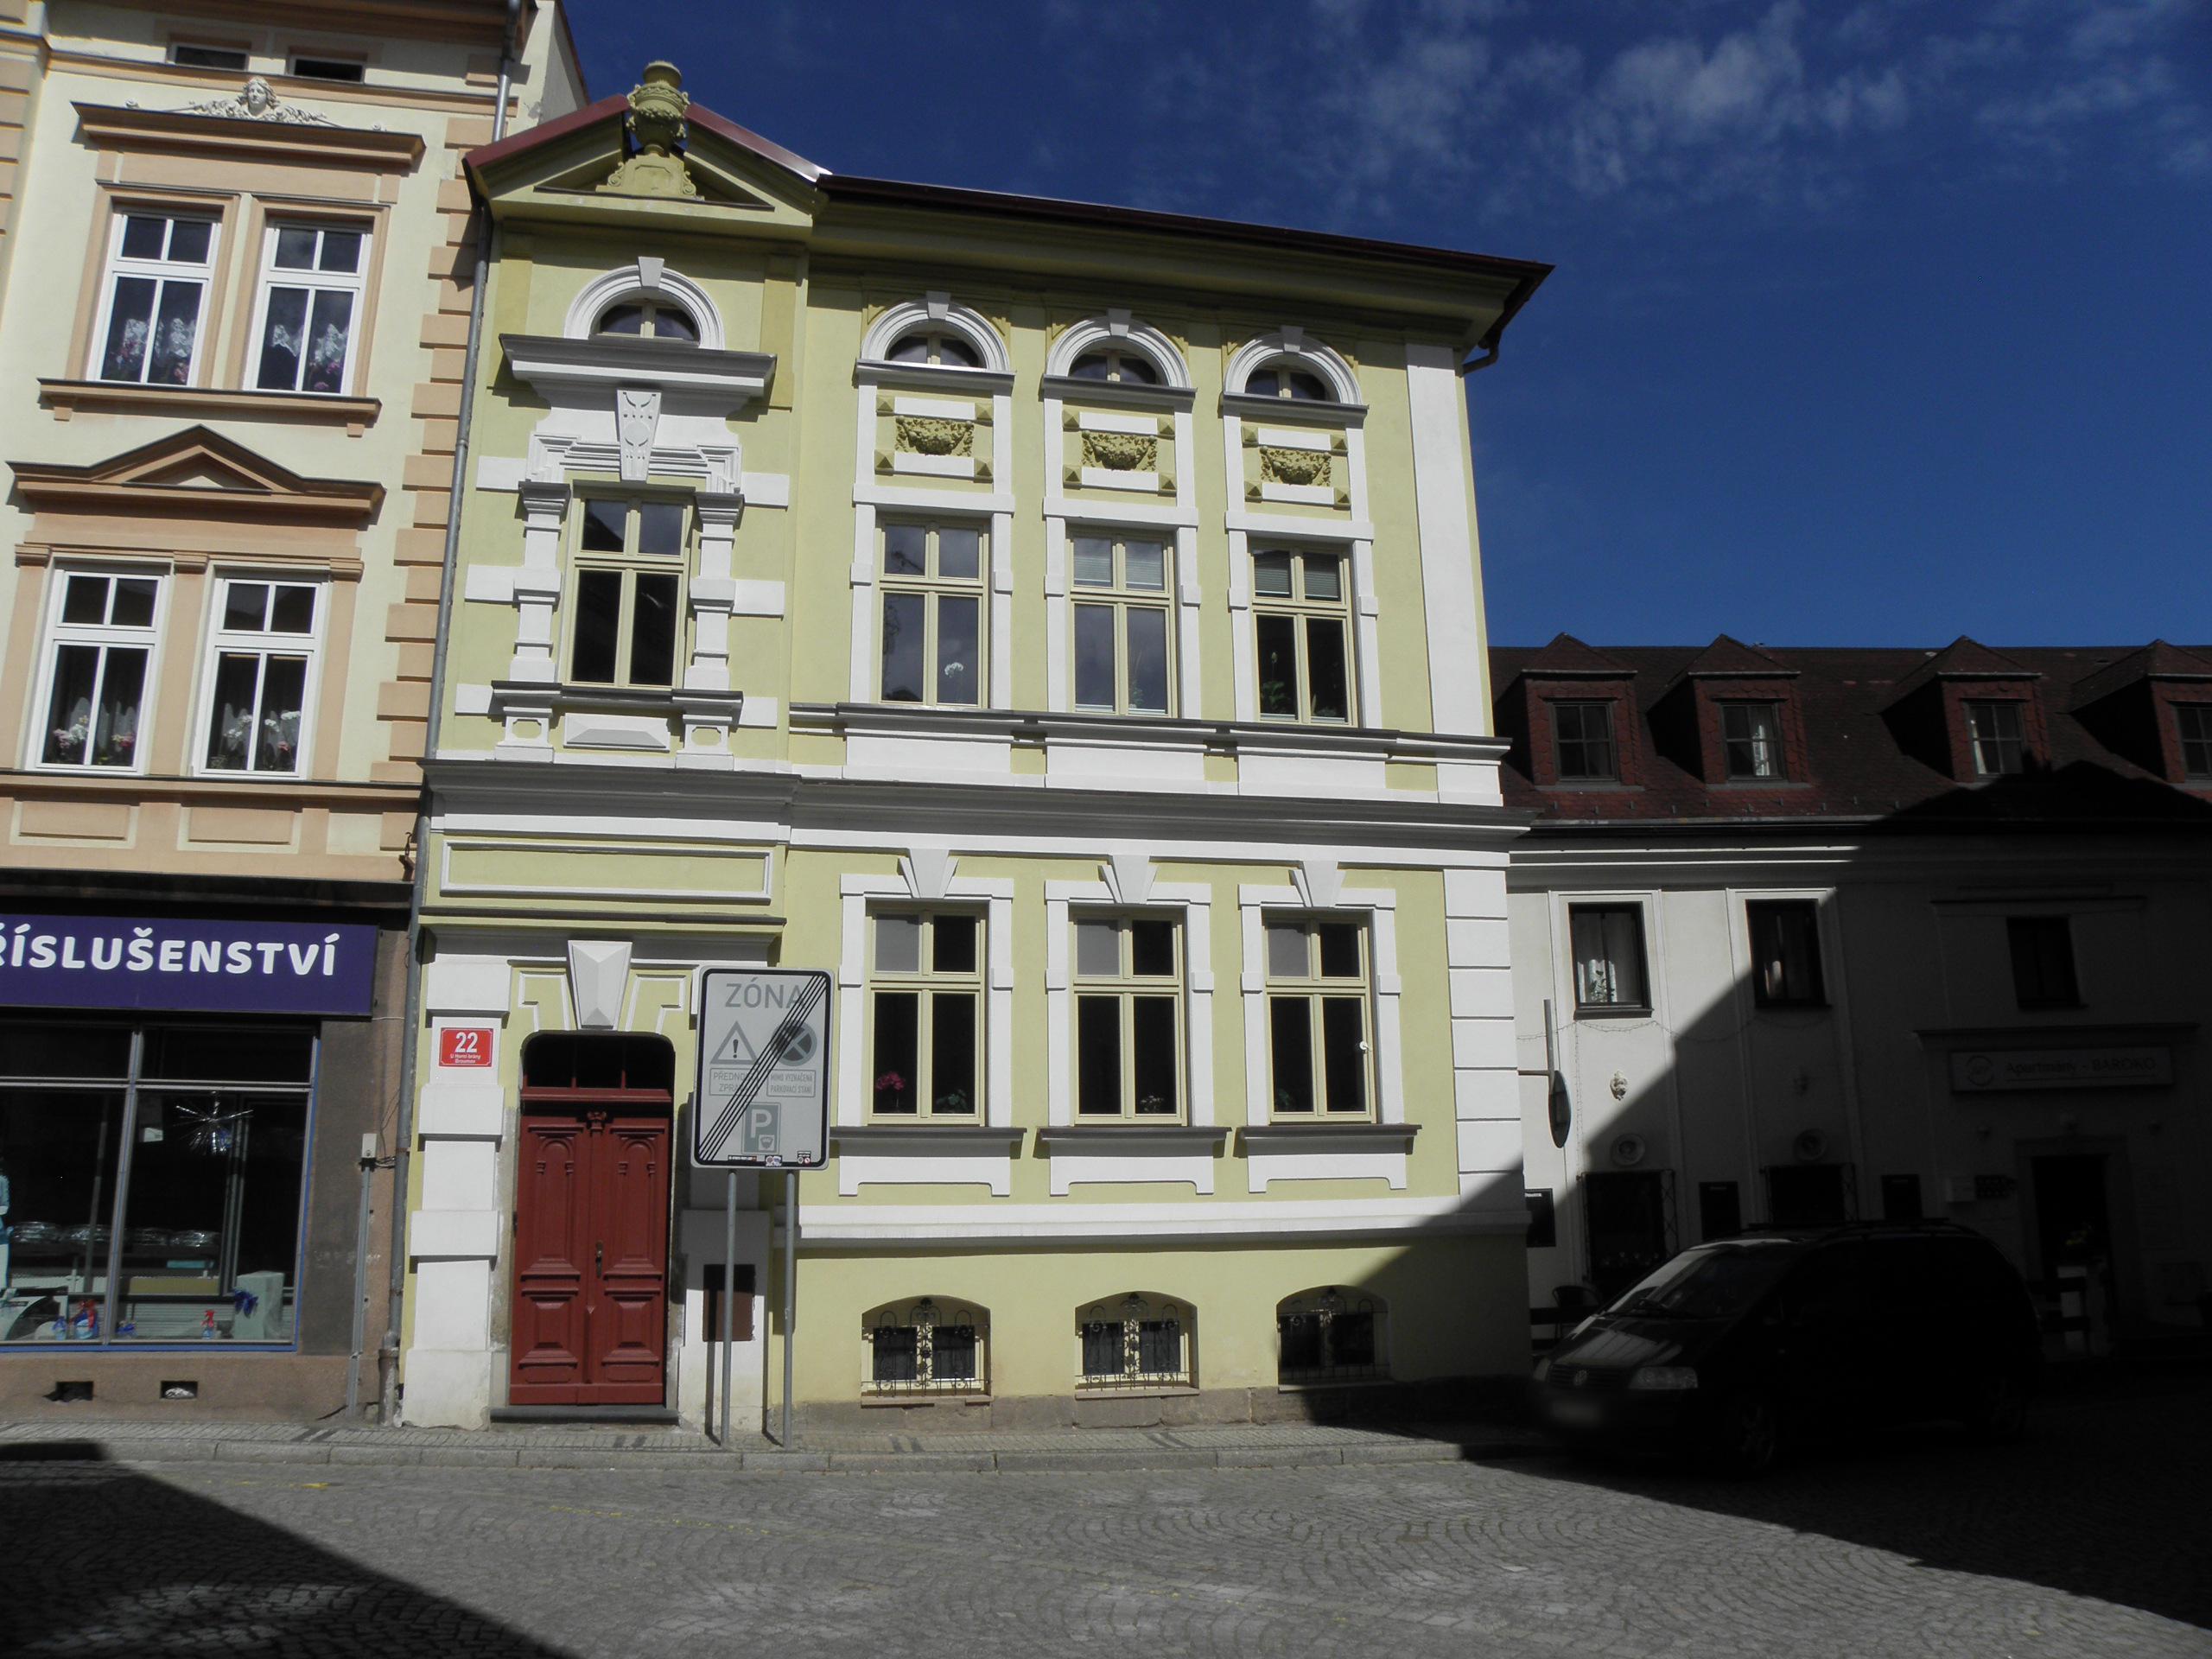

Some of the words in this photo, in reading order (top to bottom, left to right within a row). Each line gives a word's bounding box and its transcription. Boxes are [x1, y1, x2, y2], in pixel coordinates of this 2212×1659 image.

[0, 922, 340, 976] ÍSLUŠENSTVÍ
[724, 976, 807, 1009] ZÓNA
[455, 1032, 478, 1053] 22
[751, 1109, 772, 1138] P
